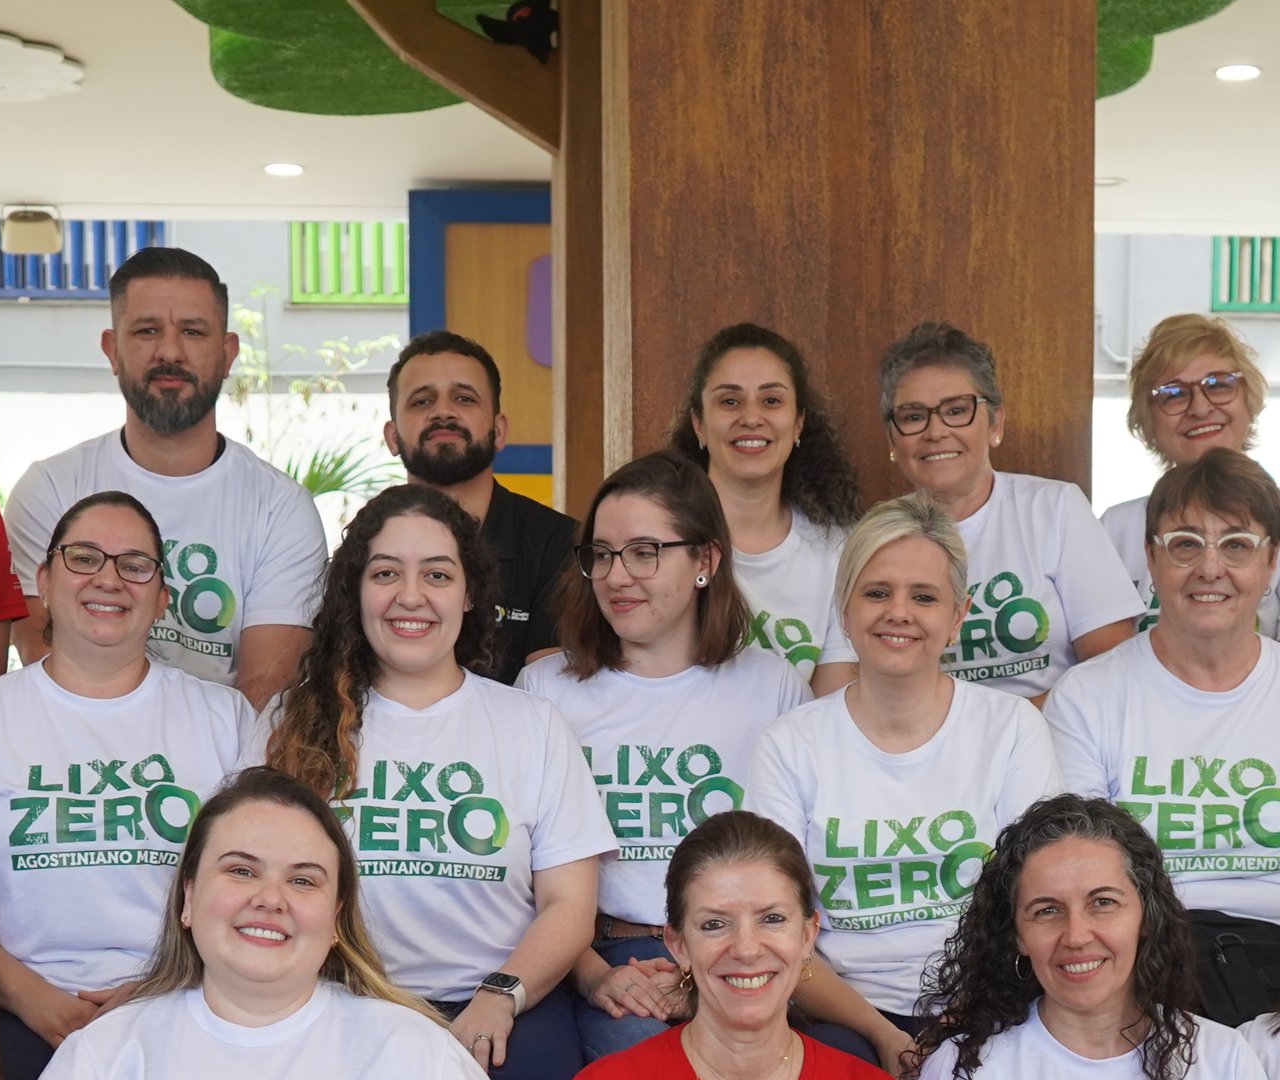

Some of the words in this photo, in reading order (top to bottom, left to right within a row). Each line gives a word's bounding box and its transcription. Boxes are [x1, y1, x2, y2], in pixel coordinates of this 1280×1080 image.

[992, 657, 1047, 677] MENDEL
[28, 753, 176, 795] LIXO
[1131, 755, 1277, 797] LIXO
[9, 784, 202, 847] ZERO
[599, 776, 744, 838] ERO
[825, 810, 977, 858] LIXO
[16, 851, 133, 869] AGOSTINIANO
[136, 850, 179, 867] MEND
[438, 862, 501, 881] MENDEL
[813, 841, 996, 910] ZERO
[830, 911, 928, 930] AGOSTINIANO
